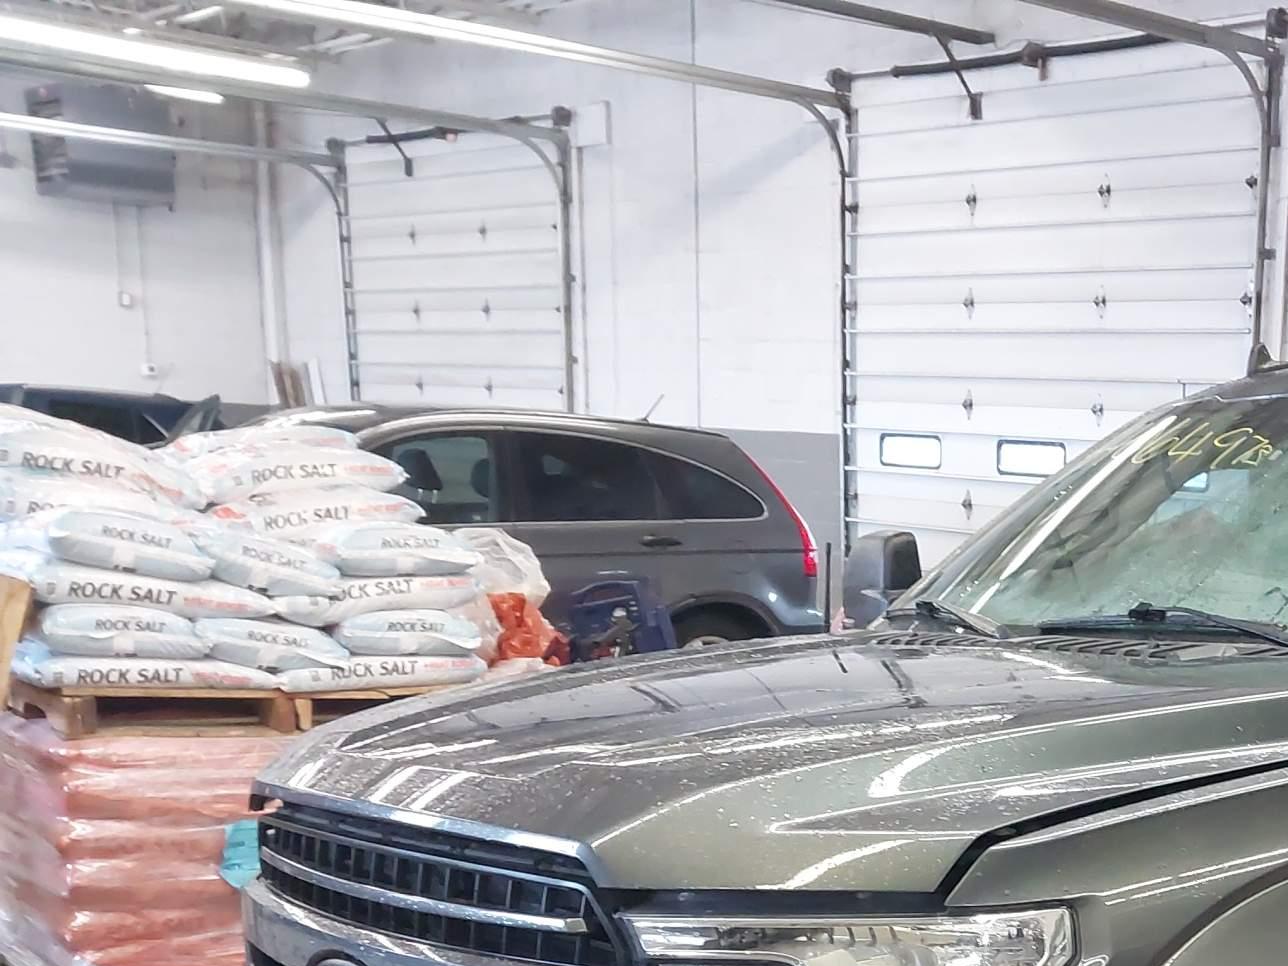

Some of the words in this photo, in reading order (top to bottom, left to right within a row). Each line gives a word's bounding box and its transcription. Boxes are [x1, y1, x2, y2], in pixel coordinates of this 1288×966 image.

[21, 451, 74, 474] ROCK
[79, 460, 125, 479] SALT
[251, 465, 294, 483] ROCK
[299, 463, 337, 479] SALT
[312, 505, 349, 522] SALT
[102, 525, 135, 542] ROCK
[141, 531, 172, 549] SALT
[67, 581, 124, 601] ROCK
[128, 586, 177, 606] SALT
[375, 578, 414, 596] SALT
[94, 619, 130, 632] ROCK
[134, 621, 167, 633] SALT
[387, 622, 418, 632] ROCK
[420, 622, 446, 633] SALT
[77, 668, 130, 686] ROCK
[136, 667, 183, 685] SALT
[331, 663, 375, 681] ROCK
[379, 660, 418, 676] SALT
